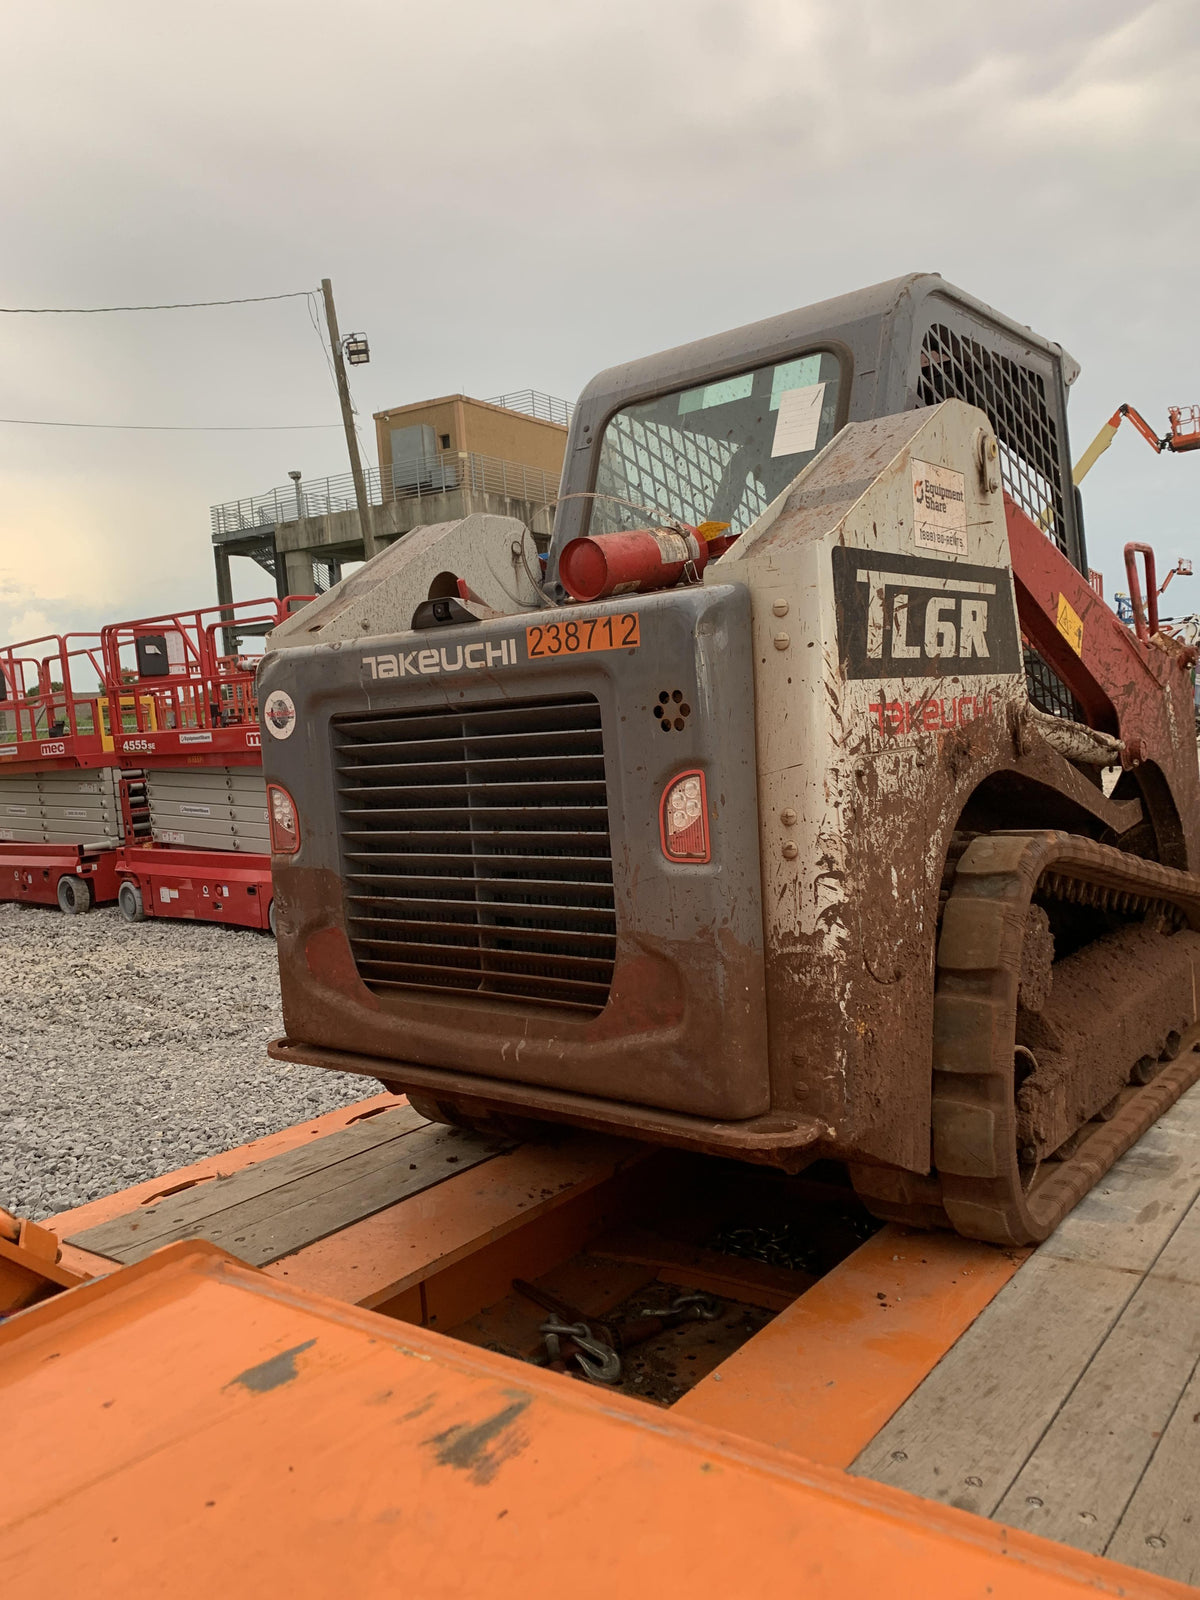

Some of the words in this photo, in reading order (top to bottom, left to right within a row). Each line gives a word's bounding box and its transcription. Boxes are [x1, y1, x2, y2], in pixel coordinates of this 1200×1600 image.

[925, 480, 964, 502] Equipment
[925, 495, 947, 513] Share
[856, 568, 997, 659] TL6R
[529, 613, 638, 657] 238712
[41, 743, 64, 754] mec
